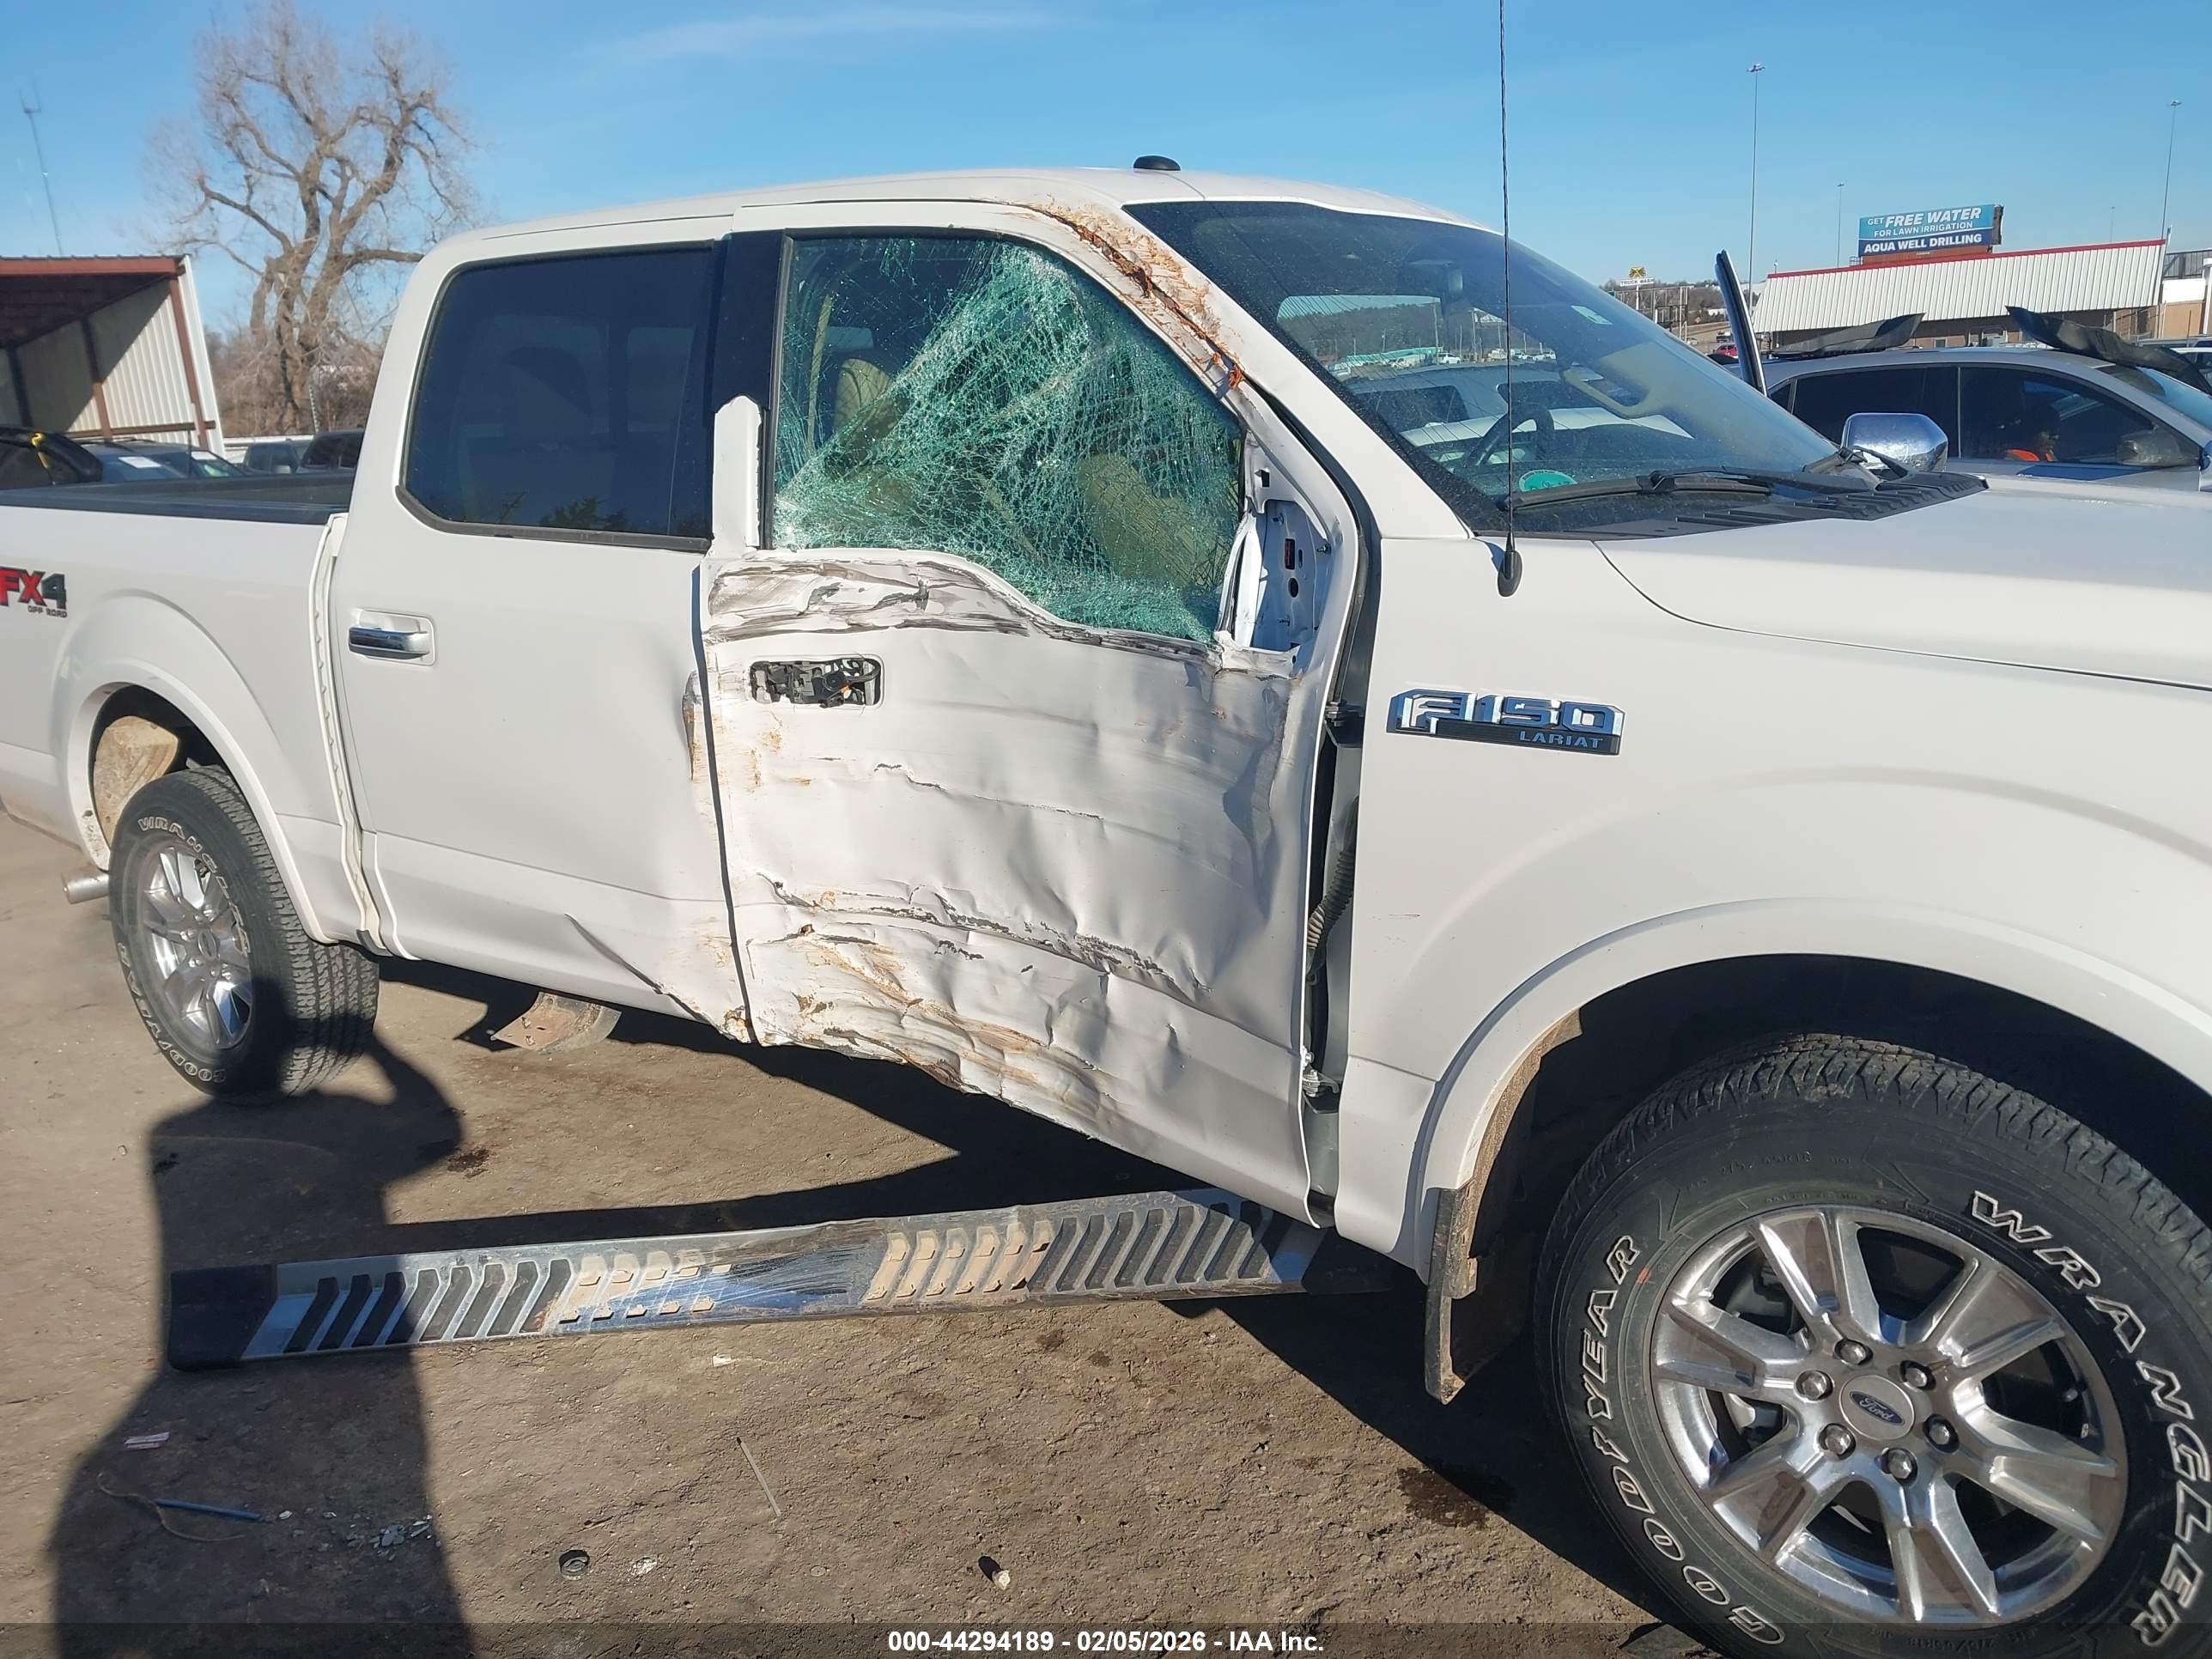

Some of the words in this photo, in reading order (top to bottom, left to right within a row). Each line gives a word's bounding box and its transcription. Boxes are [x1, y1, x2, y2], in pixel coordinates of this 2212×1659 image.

[1868, 216, 1884, 226] GET
[1885, 212, 1923, 228] FREE
[1927, 207, 1982, 223] WATER
[1893, 226, 1919, 236] LAWN
[1921, 221, 1973, 234] IRRIGATION
[1863, 243, 1896, 253] AQUA
[1898, 239, 1927, 251] WELL
[1929, 234, 1982, 247] DRILLING
[0, 566, 67, 610] FX4
[1519, 730, 1604, 749] LARIAT
[1859, 1397, 1894, 1421] Ford
[1972, 1190, 2212, 1647] WRANGLER
[1582, 1235, 1785, 1644] GOODYEAR
